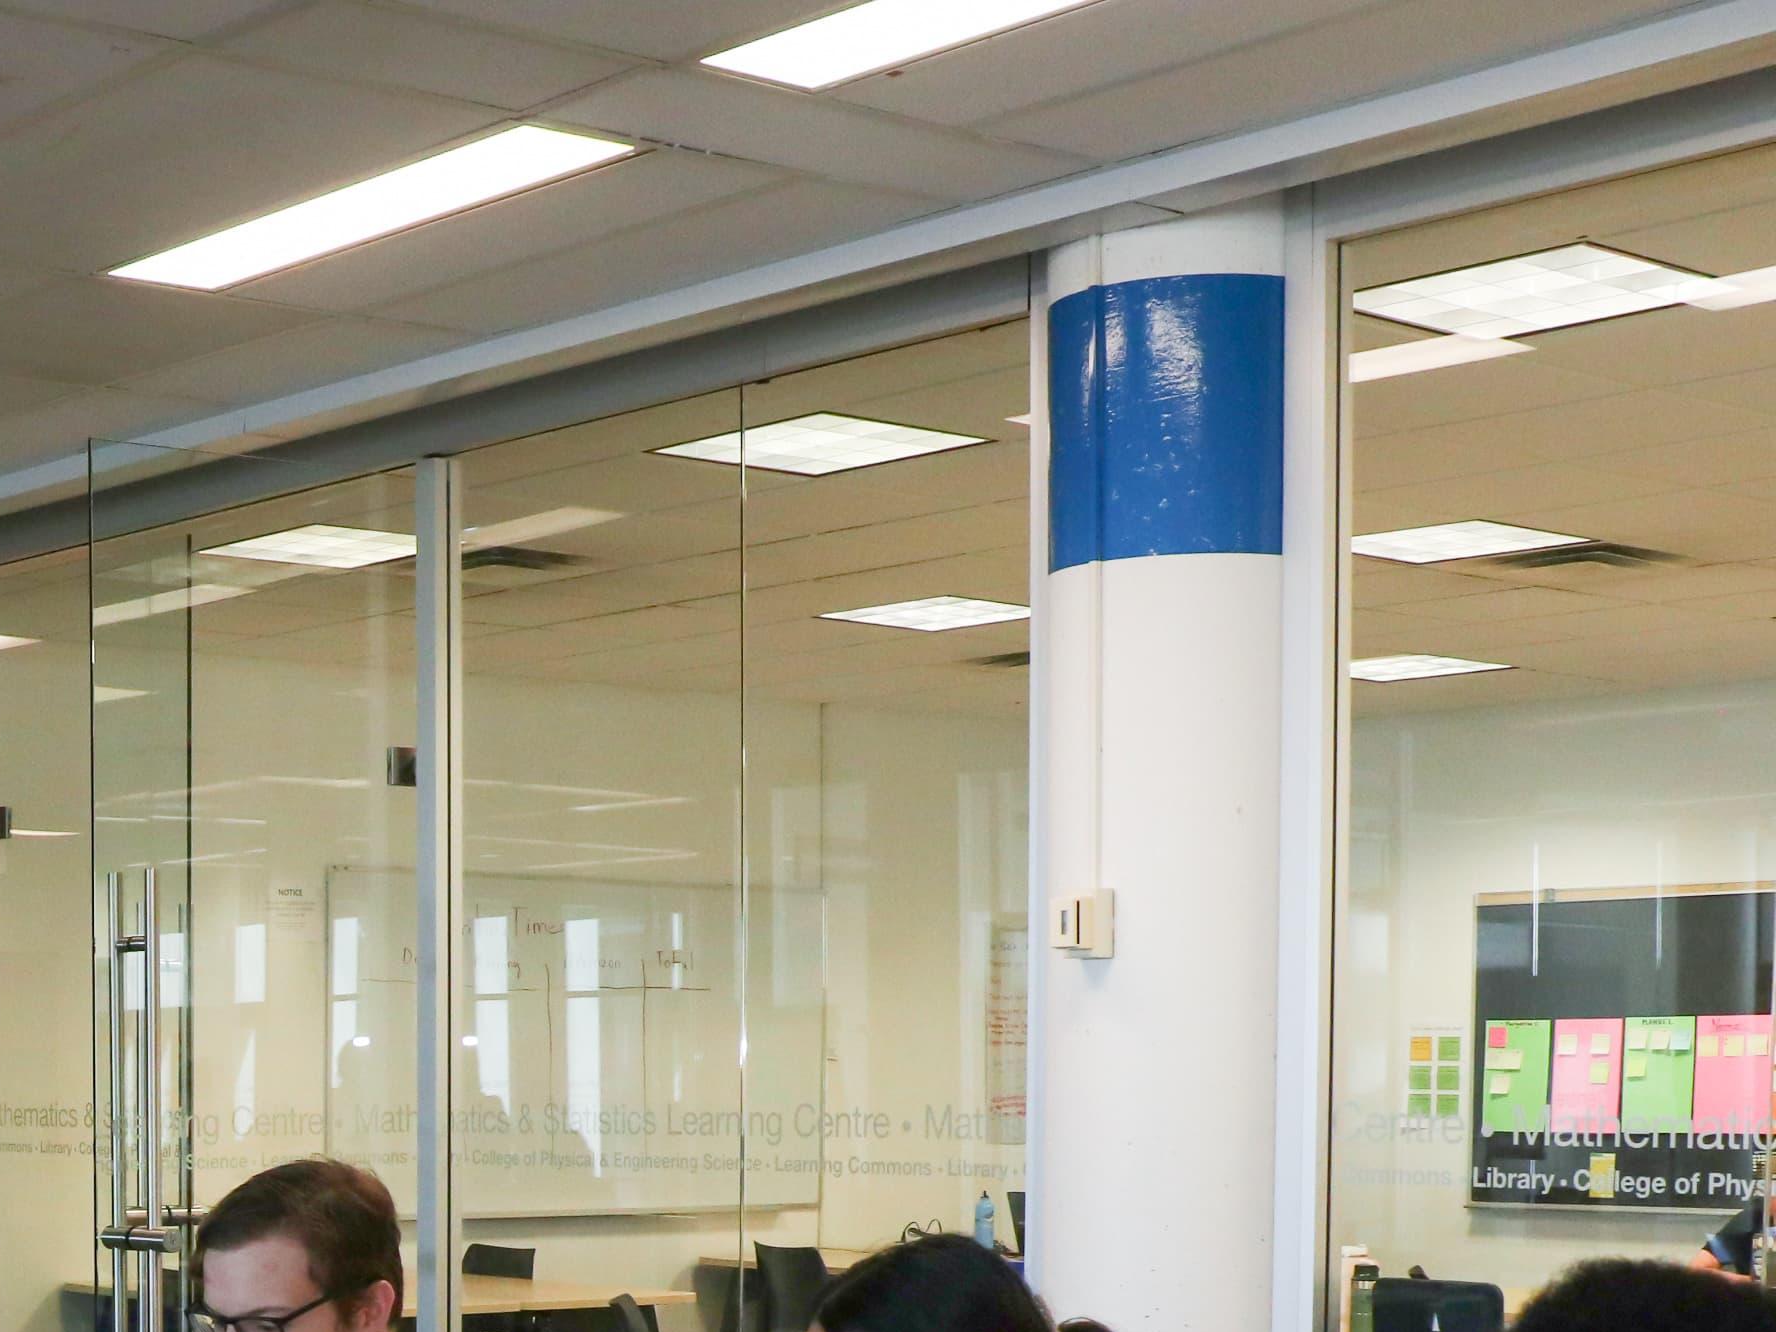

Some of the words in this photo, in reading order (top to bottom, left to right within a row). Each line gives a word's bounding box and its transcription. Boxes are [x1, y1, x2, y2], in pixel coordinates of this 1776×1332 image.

[277, 888, 304, 897] NOTICE
[232, 1105, 322, 1137] Centre
[518, 1104, 534, 1134] &
[543, 1103, 656, 1137] Statistics
[667, 1103, 783, 1146] Learning
[793, 1103, 891, 1139] Centre
[40, 1141, 72, 1156] Library
[186, 1153, 249, 1170] Science
[472, 1150, 521, 1169] College
[525, 1151, 536, 1166] of
[541, 1151, 593, 1170] Physical
[600, 1153, 609, 1167] &
[613, 1151, 698, 1172] Engineering
[703, 1153, 762, 1172] Science
[774, 1155, 843, 1178] Learning
[847, 1156, 932, 1176] Commons
[947, 1159, 1008, 1180] Library
[1472, 1166, 1555, 1195] Library
[1573, 1168, 1667, 1198] College
[1675, 1172, 1700, 1195] of
